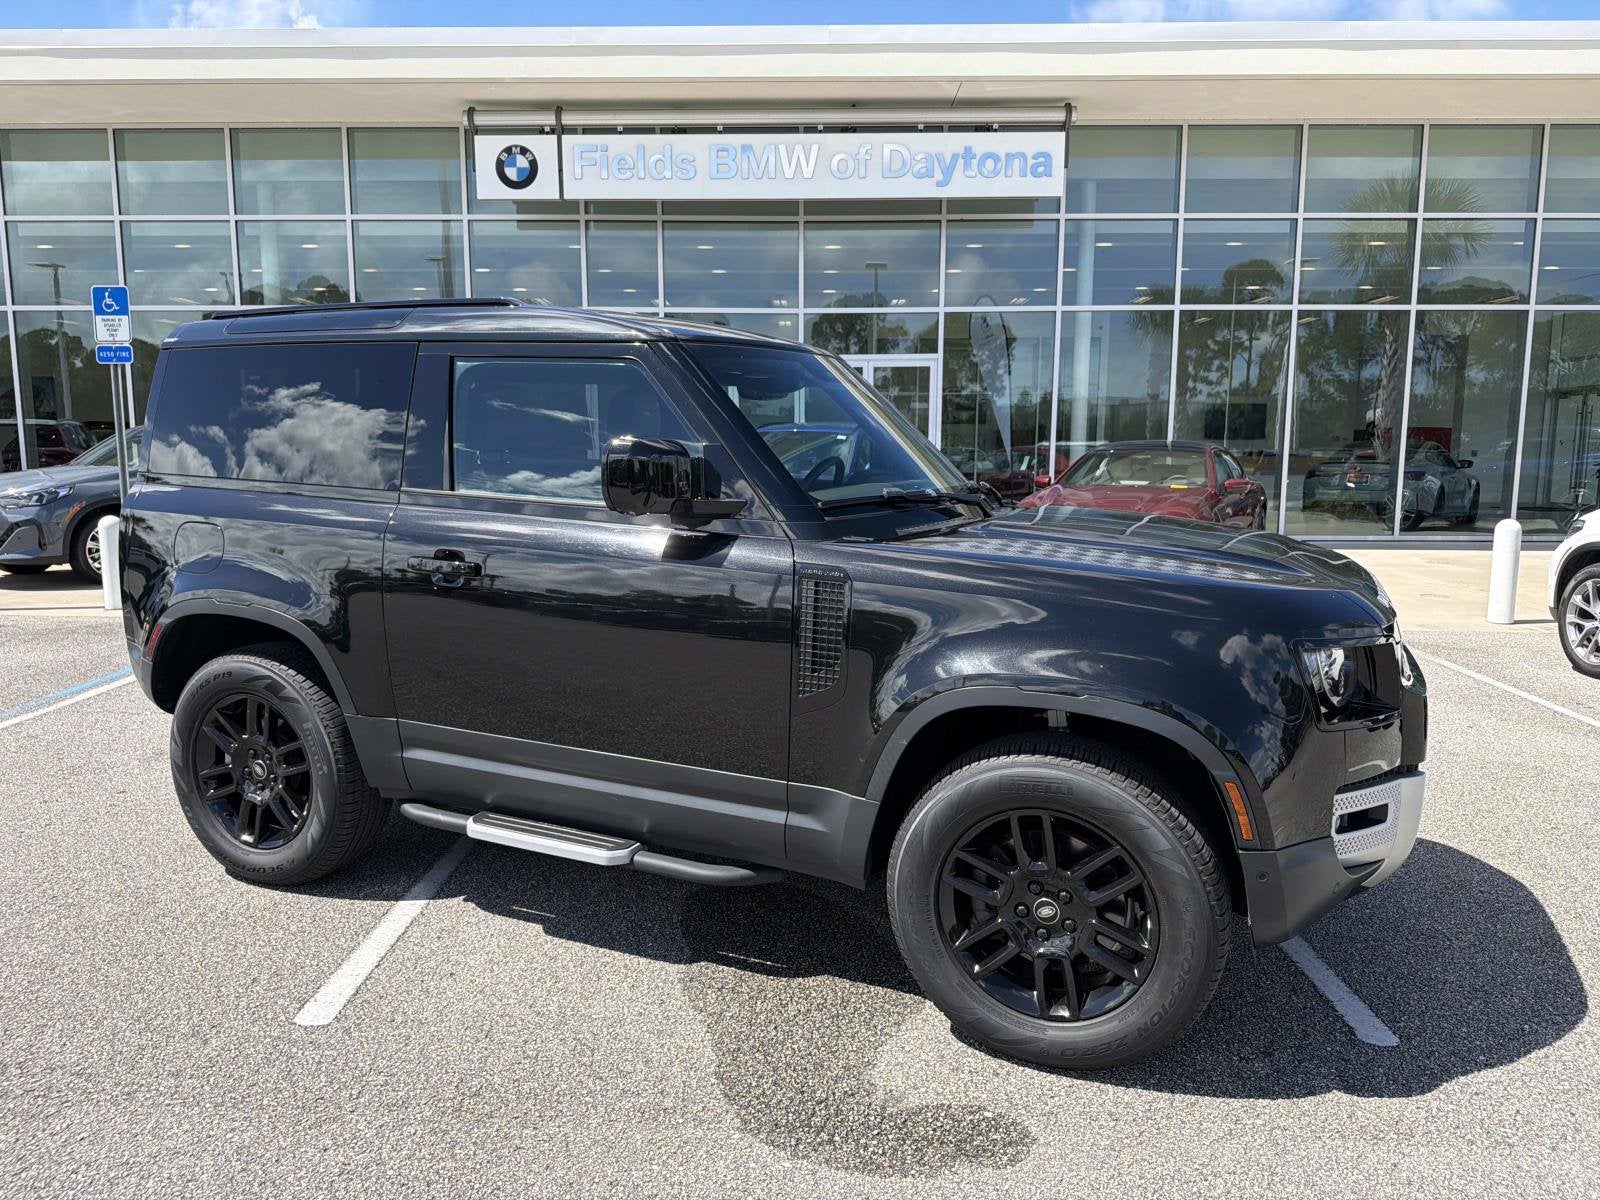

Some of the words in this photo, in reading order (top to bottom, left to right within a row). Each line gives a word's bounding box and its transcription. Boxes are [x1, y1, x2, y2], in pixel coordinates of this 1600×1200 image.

[499, 146, 535, 161] BMW
[573, 143, 697, 180] Fields
[708, 143, 820, 180] BMW
[829, 143, 872, 180] of
[881, 143, 1053, 188] Daytona
